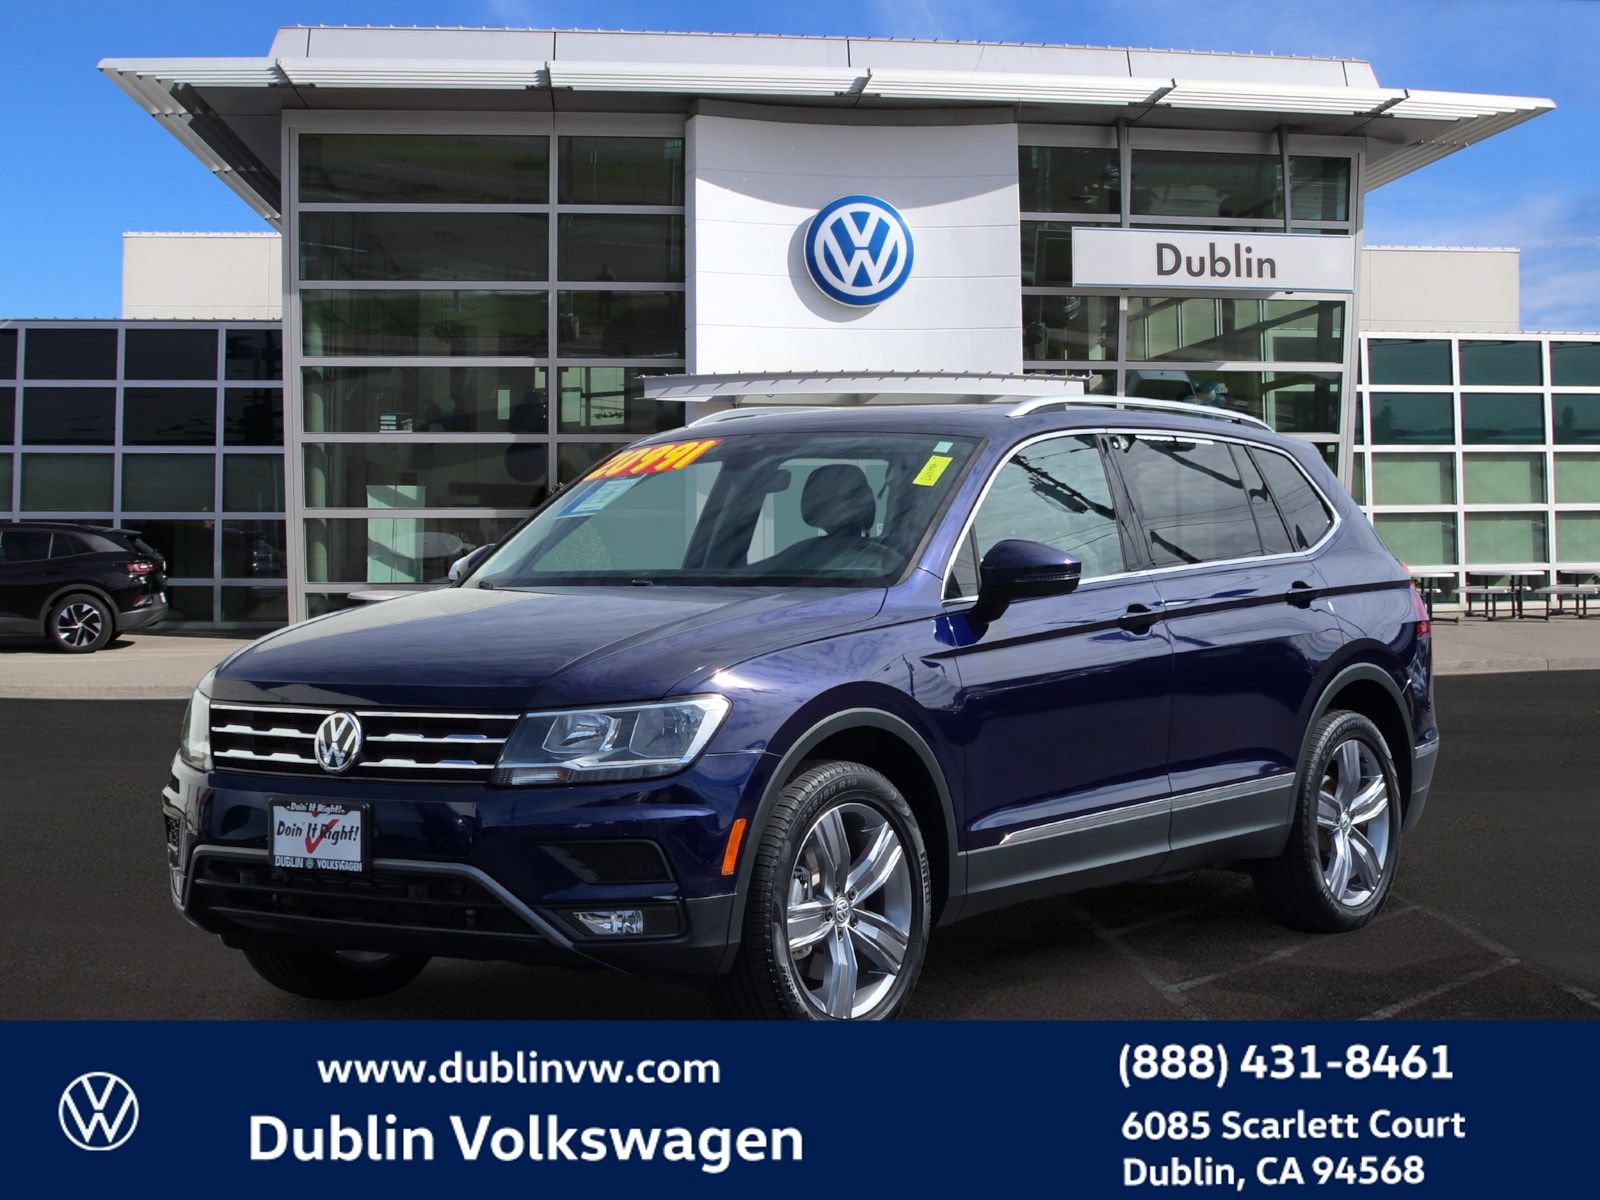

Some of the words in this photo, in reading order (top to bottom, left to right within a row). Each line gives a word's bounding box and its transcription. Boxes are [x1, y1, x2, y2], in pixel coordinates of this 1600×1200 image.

[1155, 242, 1277, 279] Dublin
[276, 820, 306, 838] Doin'
[306, 822, 318, 839] It
[320, 824, 360, 845] Right!
[275, 855, 304, 868] DUBLIN
[317, 860, 363, 872] VOLKSWAGEN
